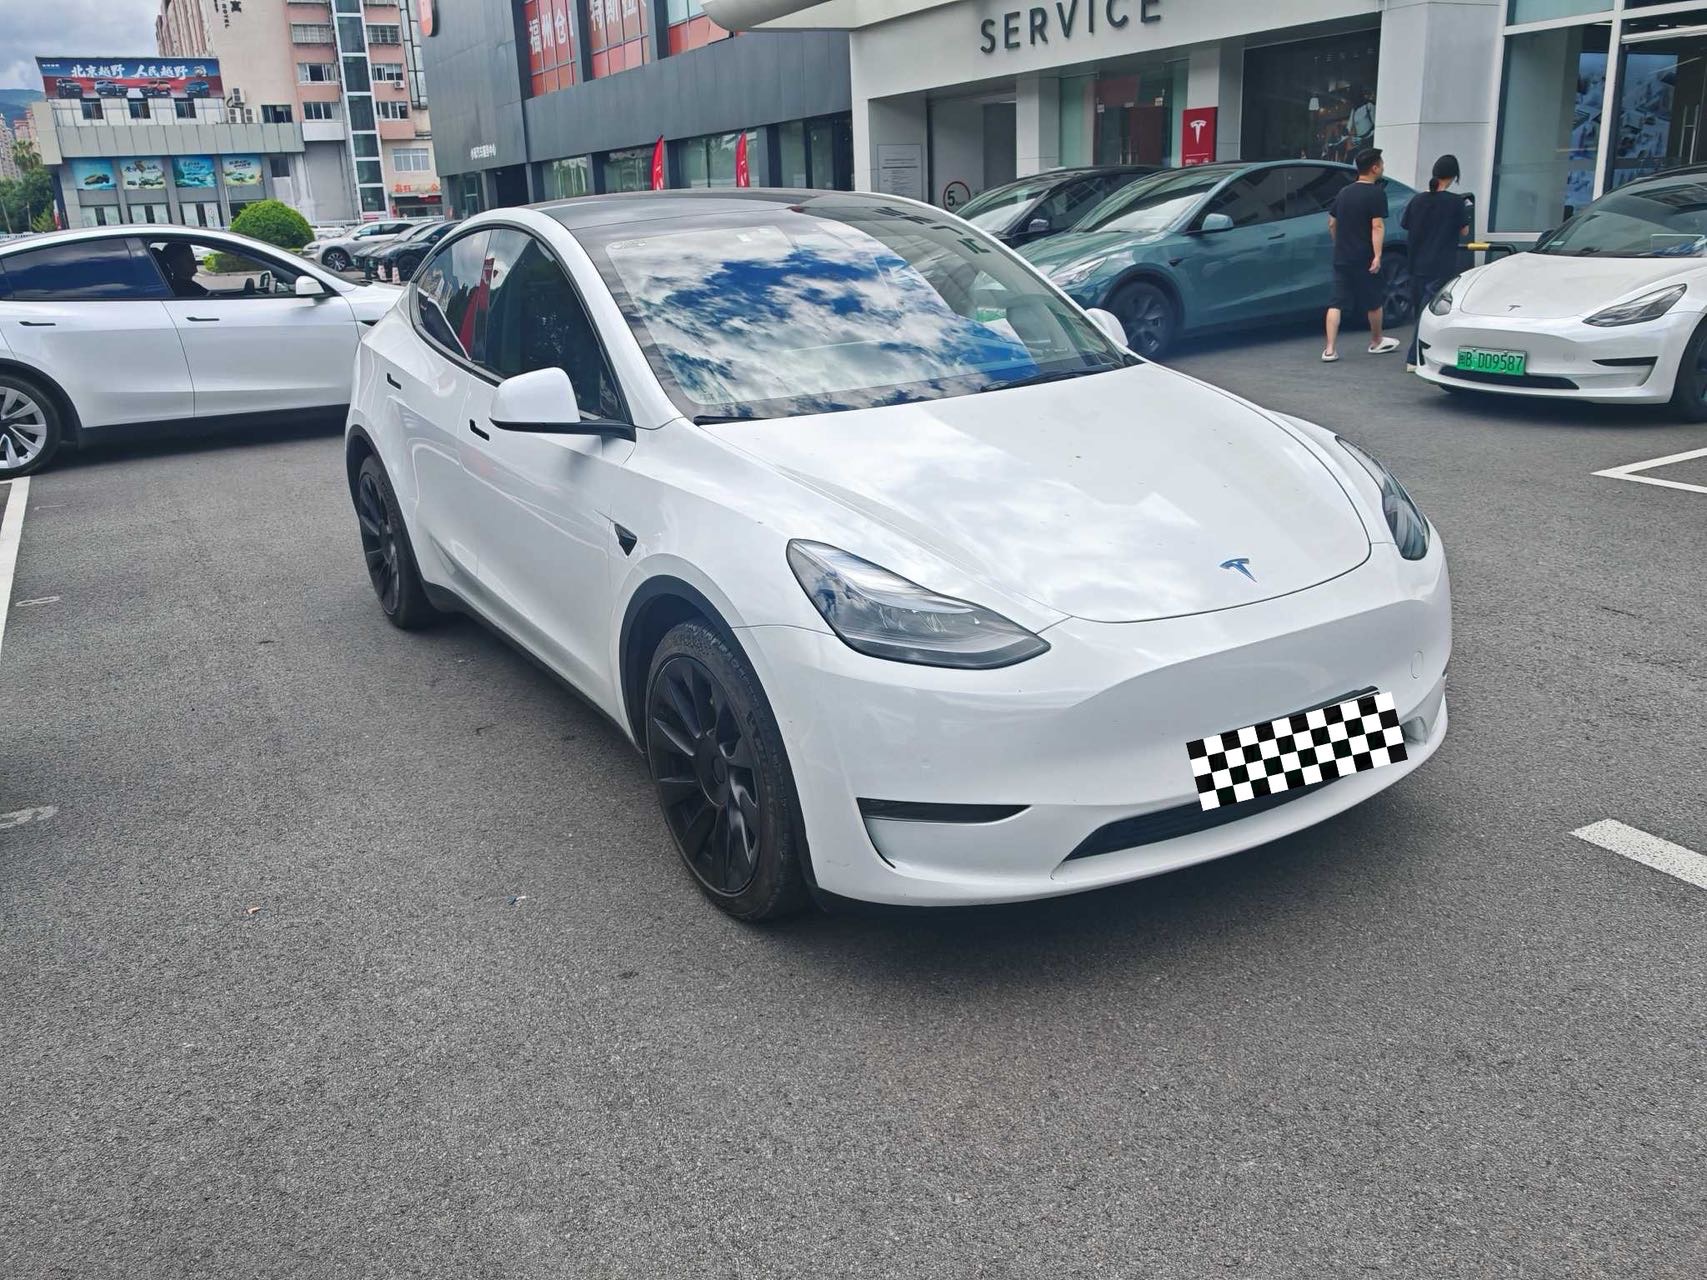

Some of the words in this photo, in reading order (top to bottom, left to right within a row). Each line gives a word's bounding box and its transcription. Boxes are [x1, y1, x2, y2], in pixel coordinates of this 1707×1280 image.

[980, 0, 1161, 54] SERVICE
[70, 64, 126, 79] 北京越野
[130, 64, 189, 81] 人民越野
[947, 189, 956, 207] 5
